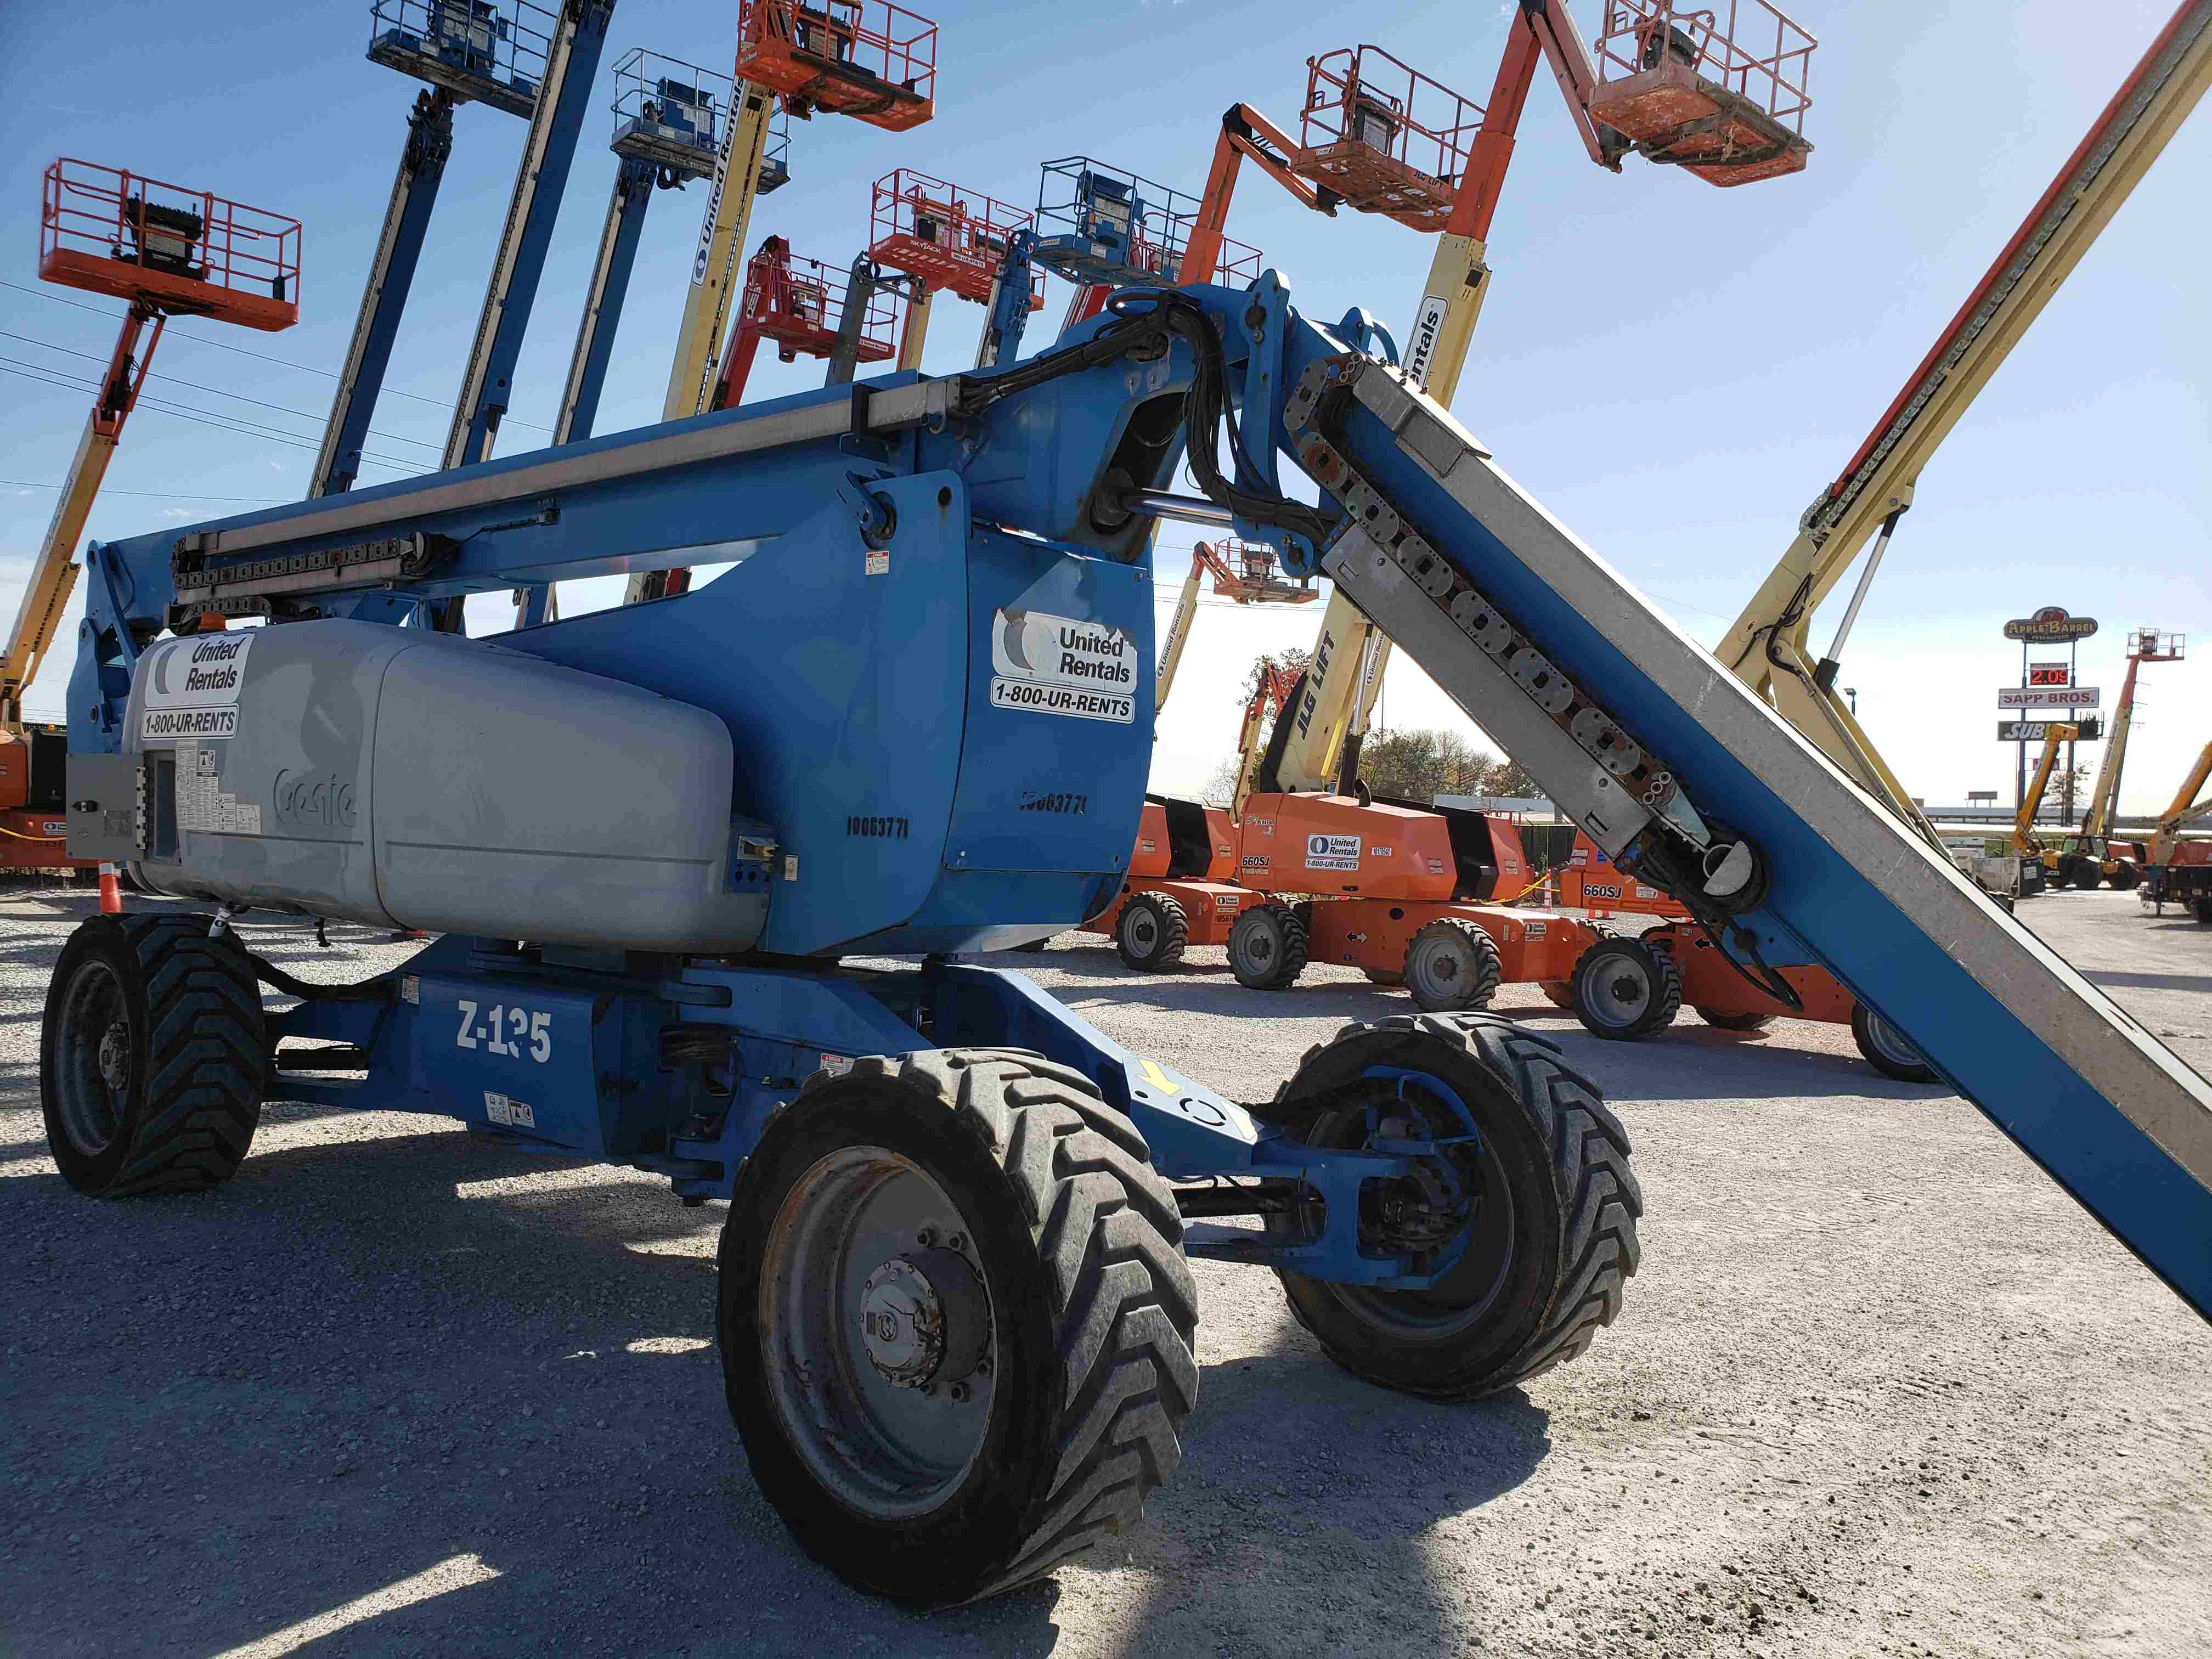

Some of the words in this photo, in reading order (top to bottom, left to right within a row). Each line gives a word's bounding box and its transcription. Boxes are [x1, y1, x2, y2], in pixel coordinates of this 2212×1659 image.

[702, 165, 724, 245] United
[720, 76, 744, 161] Rentals
[1409, 310, 1438, 385] entals
[1060, 627, 1124, 657] United
[1161, 636, 1174, 665] United
[1170, 602, 1185, 636] Rentals
[191, 636, 247, 663] United
[185, 664, 238, 691] Rentals
[1060, 652, 1130, 683] Rentals
[1296, 689, 1317, 741] JLG
[1311, 629, 1335, 690] LIFT
[2004, 693, 2042, 703] SAPP
[2048, 692, 2095, 703] BROS.
[996, 684, 1130, 716] 1-800-UR-RENTS
[146, 712, 235, 733] 1-800-UR-RENTS
[273, 768, 359, 827] Genie
[1329, 847, 1358, 856] Rentals
[1330, 838, 1357, 847] United
[1242, 856, 1269, 866] 660SJ
[1307, 860, 1357, 869] 1-800-UR-RENTS
[1583, 884, 1622, 899] 660SJ
